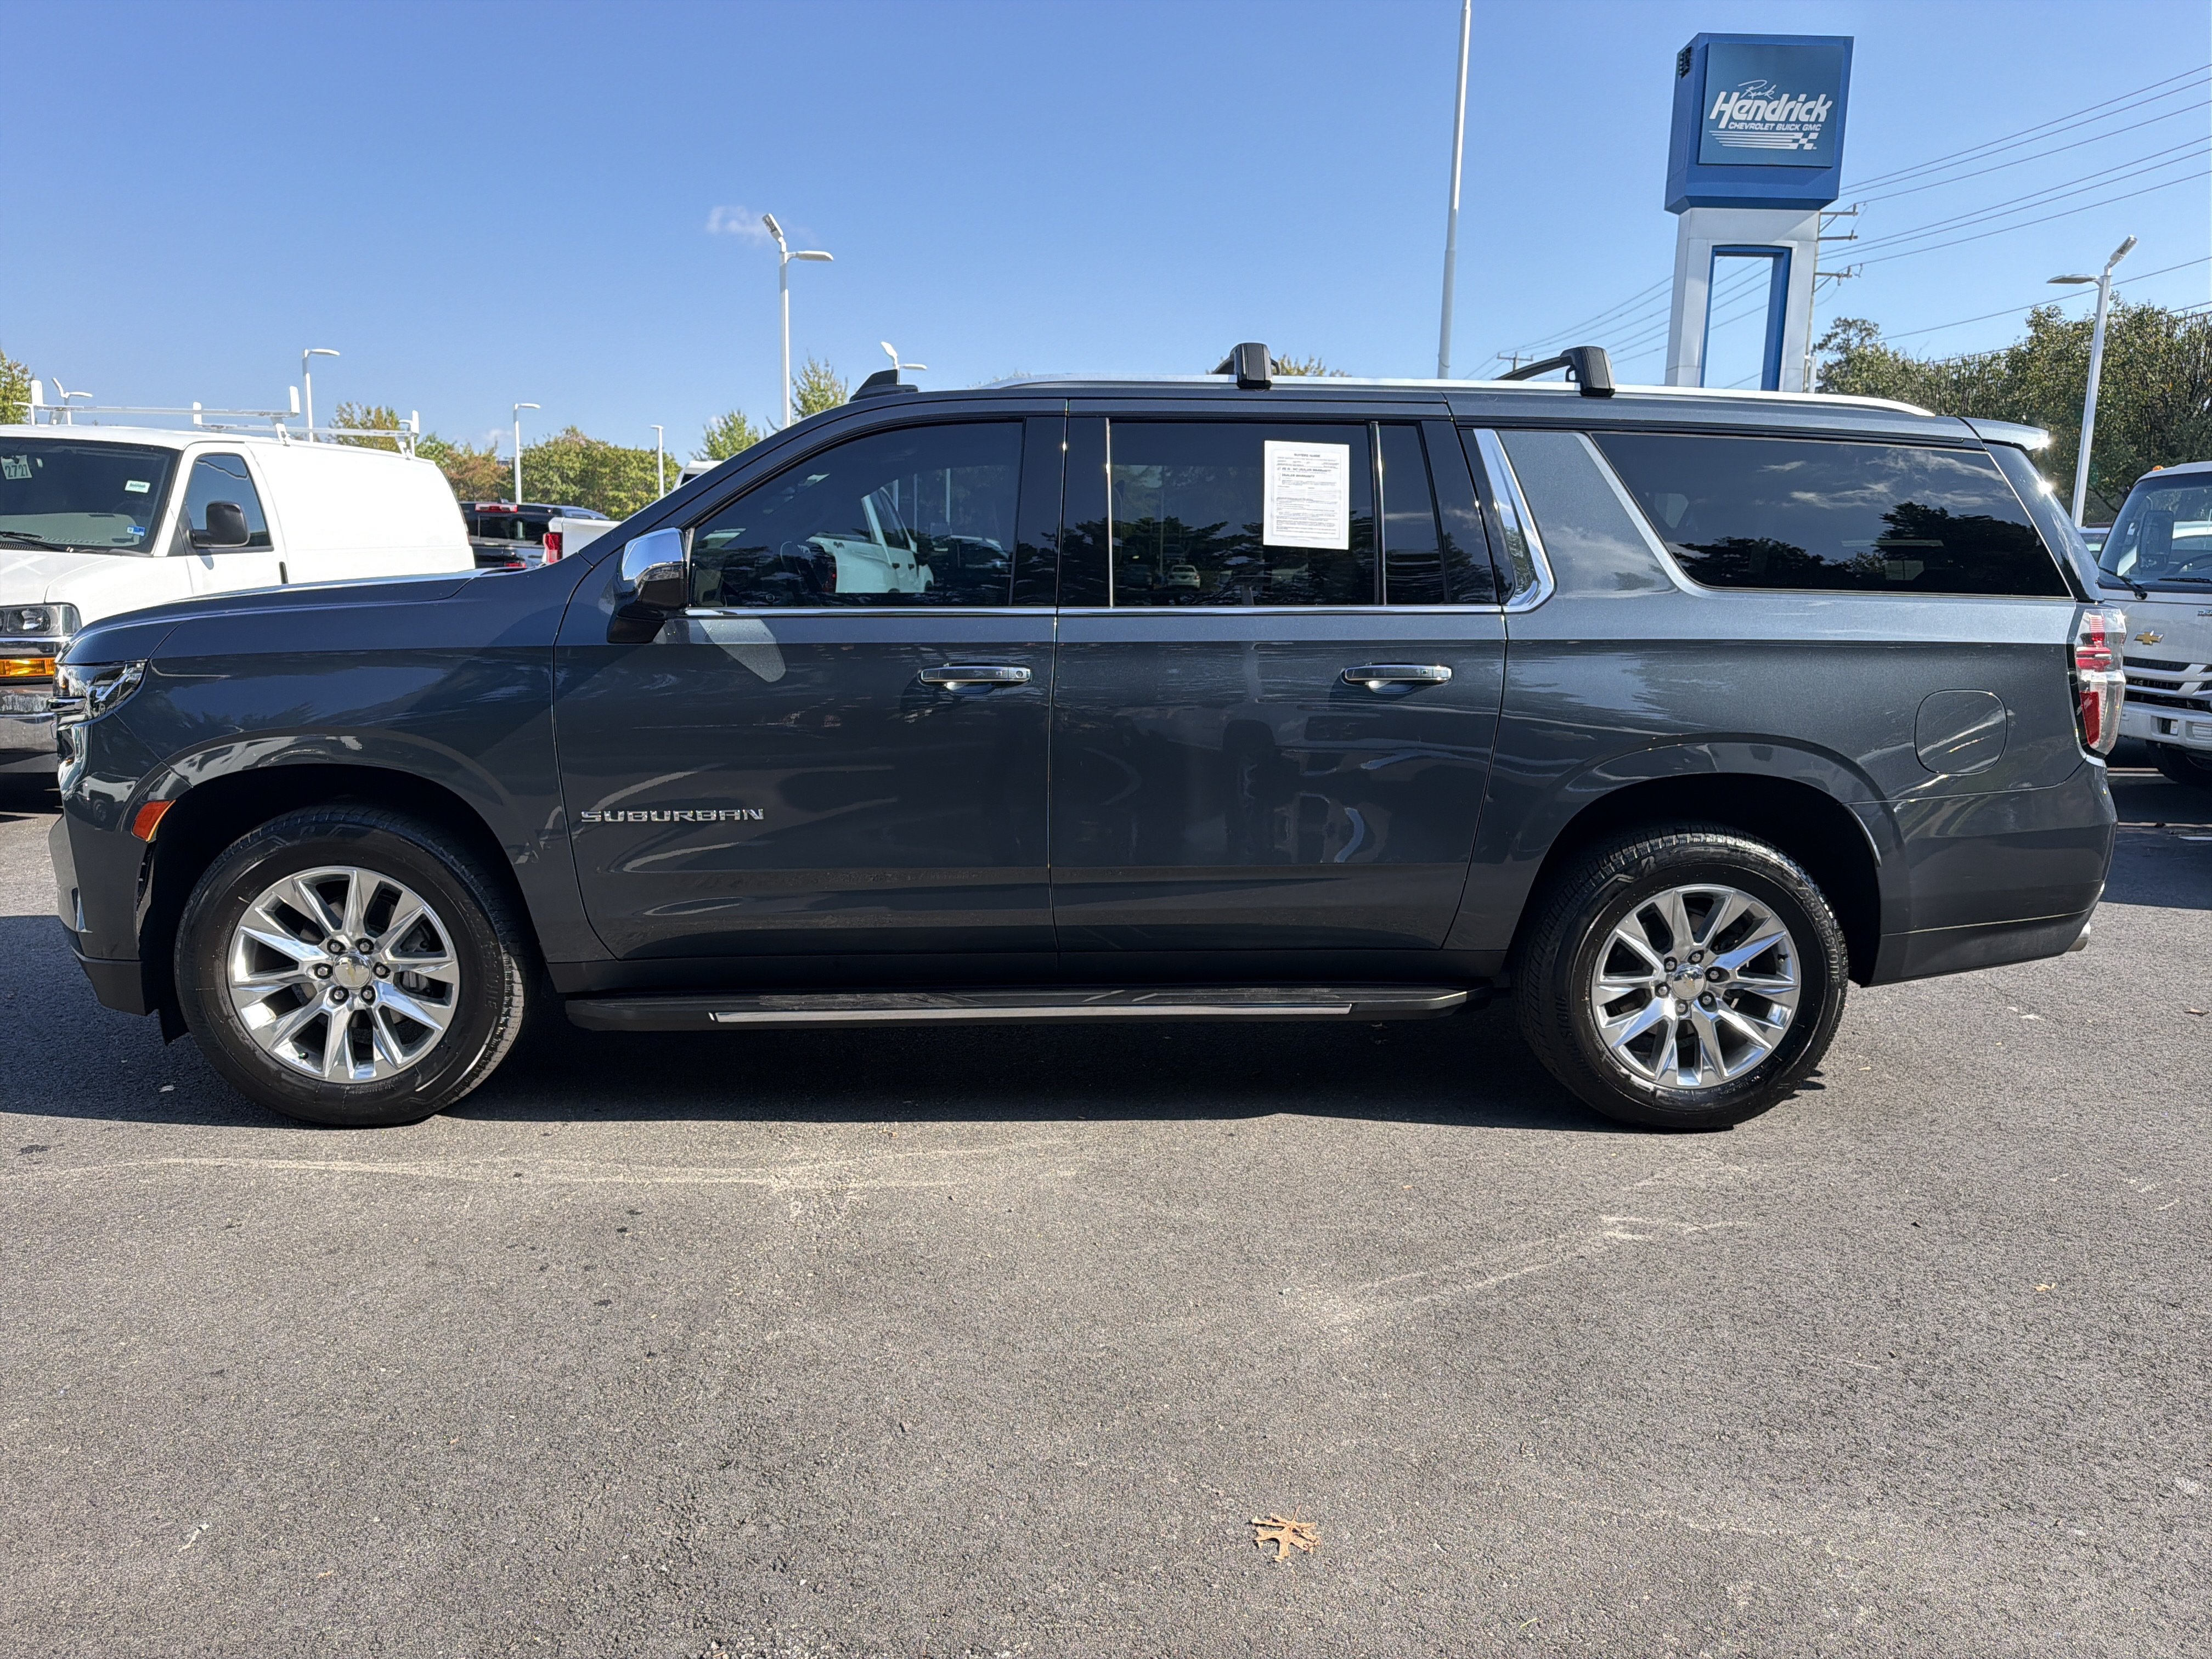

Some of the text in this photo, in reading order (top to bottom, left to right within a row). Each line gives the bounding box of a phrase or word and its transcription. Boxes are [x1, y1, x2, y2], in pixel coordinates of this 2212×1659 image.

[1709, 91, 1833, 128] Hendrick
[1728, 121, 1775, 131] CHEVROLET
[1776, 123, 1799, 131] BUICK
[581, 809, 764, 822] SUBURBAN
